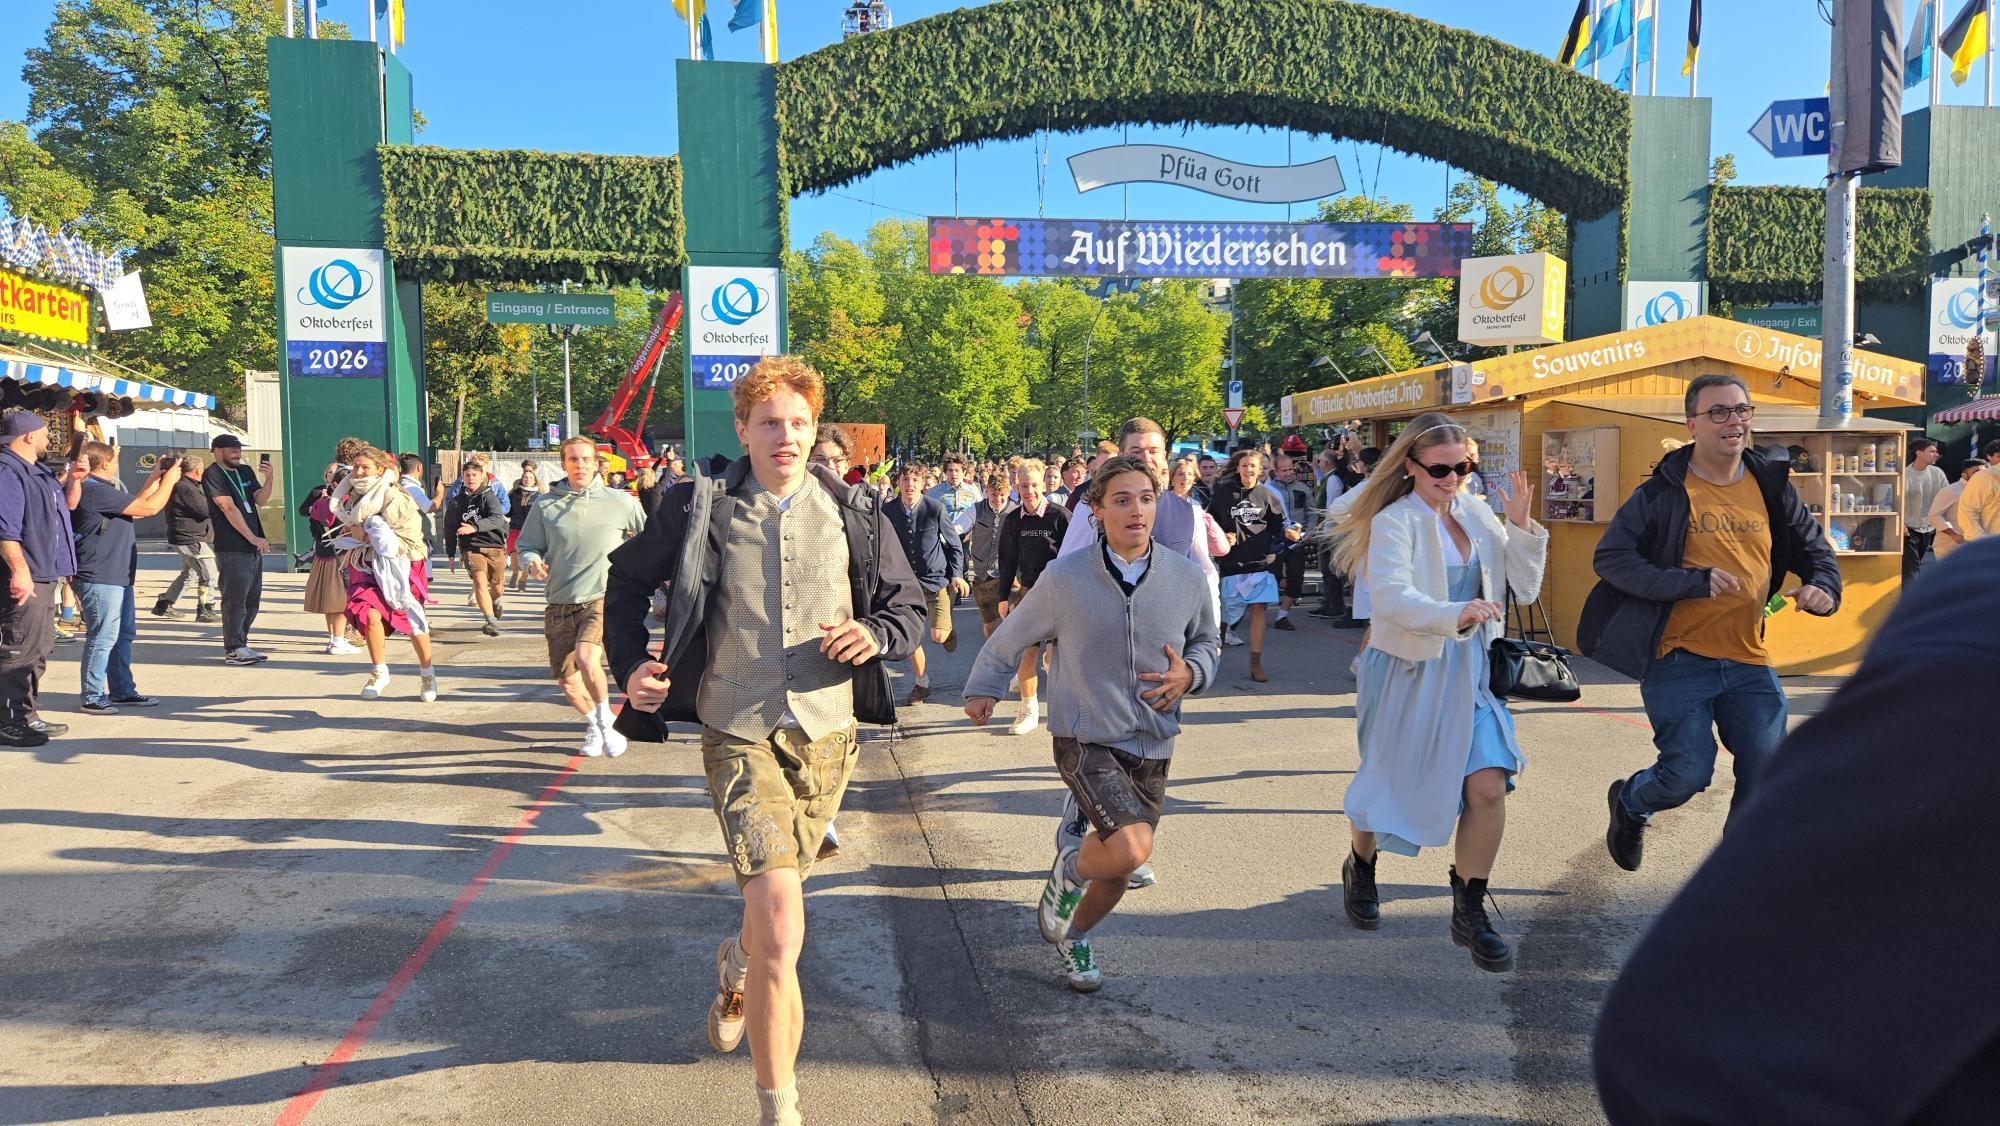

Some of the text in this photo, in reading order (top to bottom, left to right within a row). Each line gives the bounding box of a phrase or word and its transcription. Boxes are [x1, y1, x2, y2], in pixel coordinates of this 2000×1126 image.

[1774, 112, 1824, 143] WC
[1160, 153, 1261, 193] Pfüa Gott
[1063, 230, 1347, 273] Auf Wiedersehen
[0, 278, 81, 323] tkarten
[492, 303, 543, 315] Eingang
[554, 304, 609, 315] Entrance
[1, 310, 15, 324] irs
[299, 316, 373, 331] Oktoberfest
[1472, 313, 1526, 325] Oktoberfest
[1747, 318, 1789, 328] Ausgang
[1797, 317, 1816, 327] Exit
[703, 331, 768, 346] Oktoberfest
[309, 349, 368, 370] 2026
[1532, 338, 1645, 379] Souvenirs
[1764, 336, 1893, 386] Infortion
[711, 363, 750, 382] 202
[1943, 361, 1962, 378] 20
[1309, 379, 1423, 418] Offizielle Oktoberfest Info
[1688, 511, 1767, 534] s.Oliver
